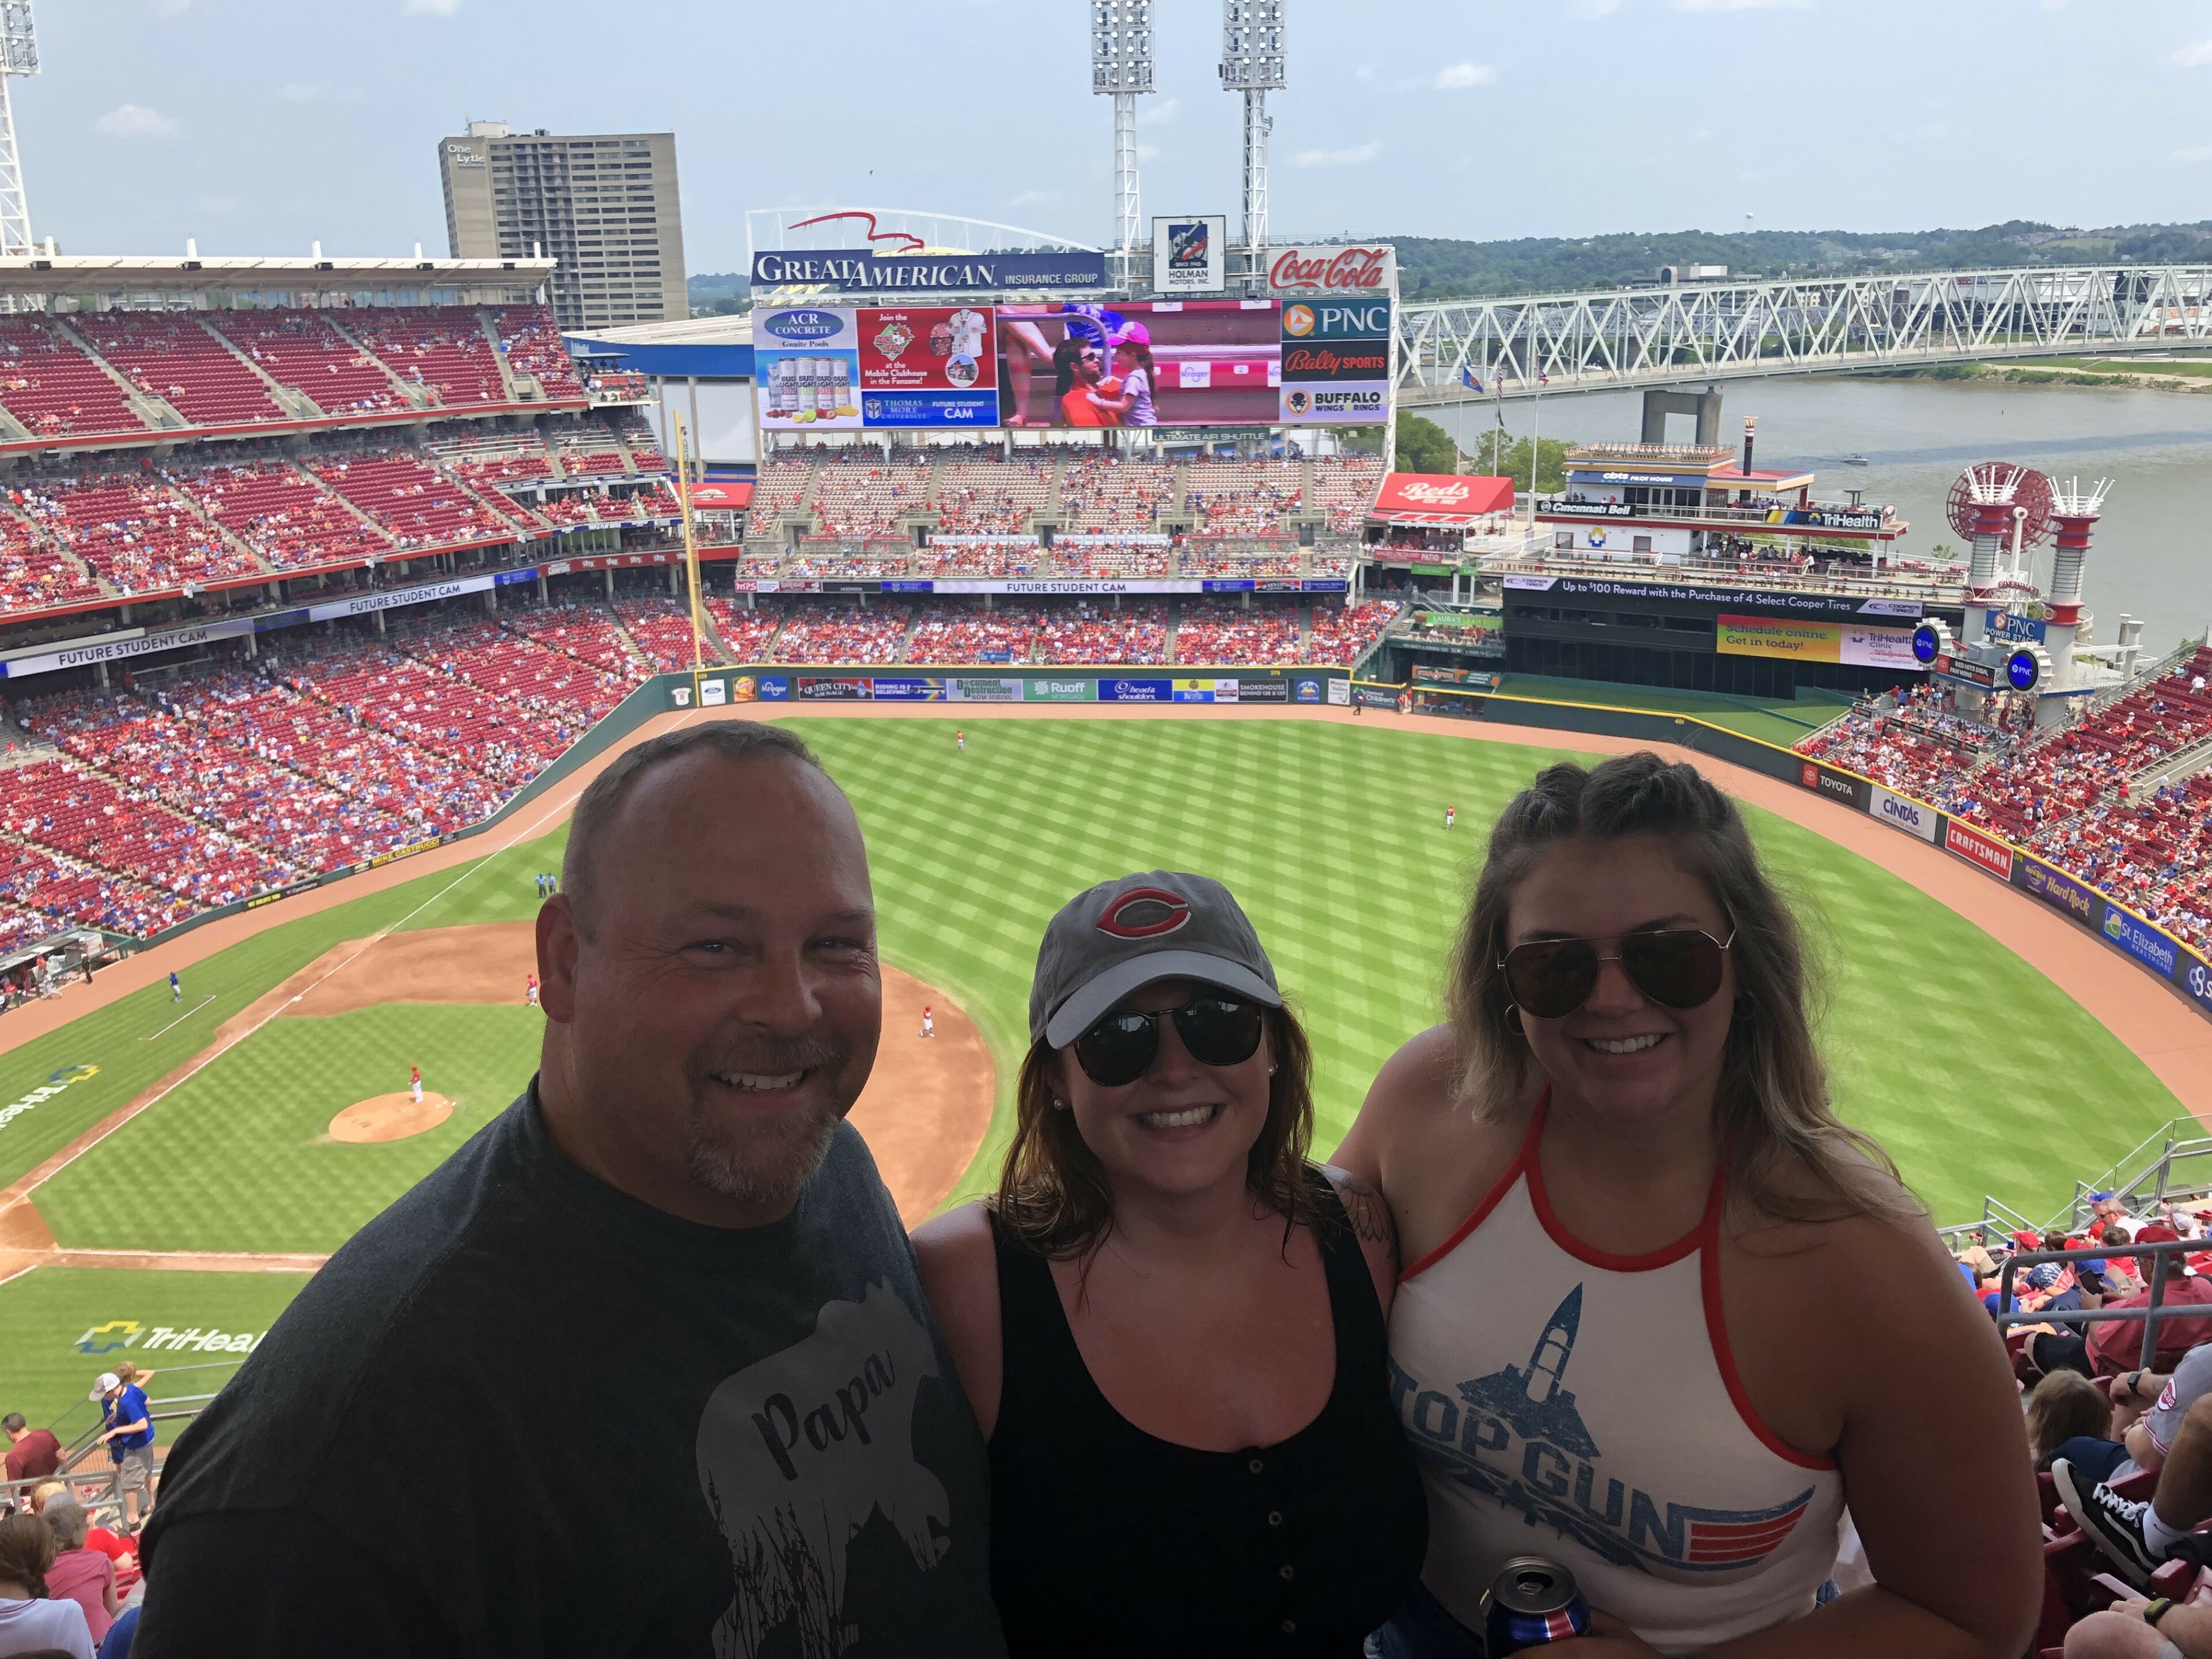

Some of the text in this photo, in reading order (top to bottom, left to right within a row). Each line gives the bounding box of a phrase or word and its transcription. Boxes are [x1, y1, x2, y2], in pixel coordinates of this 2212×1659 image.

[448, 144, 471, 153] One
[457, 154, 486, 164] Lytle
[757, 255, 855, 282] GREAT
[1005, 274, 1062, 285] INSURANCE
[1064, 274, 1098, 283] GROUP
[1169, 270, 1209, 278] HOLMAN
[1270, 248, 1390, 289] Coca-Cola
[788, 313, 819, 324] ACR
[1319, 306, 1388, 332] PNC
[775, 326, 831, 335] CONCRETE
[1285, 350, 1385, 376] Bally SPORTS
[1181, 367, 1209, 382] Kroger
[1315, 392, 1381, 404] BUFFALO
[944, 408, 974, 419] CAM
[1397, 482, 1469, 501] Reds
[1552, 502, 1631, 515] Cincinnati Bell
[1821, 513, 1878, 528] TriHealth
[1421, 554, 1440, 562] PATIO
[1007, 583, 1126, 592] FUTURE STUDENT CAM
[350, 583, 461, 612] FUTURE STUDENT CAM
[1563, 581, 1575, 592] Up
[1613, 585, 1646, 596] Reward
[1649, 586, 1668, 597] with
[1671, 588, 1687, 599] the
[1688, 589, 1731, 603] Purchase
[1733, 593, 1744, 603] of
[1745, 594, 1753, 603] 4
[1756, 594, 1786, 607] Select
[1788, 597, 1825, 609] Cooper
[1827, 600, 1851, 611] Tires
[1433, 615, 1461, 623] LAURA'S
[1726, 624, 1783, 637] Schedule
[1986, 626, 2010, 639] POWER
[2007, 617, 2035, 637] PNC
[59, 631, 207, 666] FUTURE STUDENT CAM
[1726, 635, 1804, 652] Get in today!
[1922, 641, 1934, 649] PNC
[1964, 663, 1975, 672] HITS
[2018, 667, 2032, 676] PNC
[762, 681, 787, 696] Kroger
[804, 682, 853, 695] QUEEN CITY
[964, 687, 1013, 698] Destruction
[1051, 683, 1085, 694] Ruoff
[1118, 691, 1156, 700] shoulders
[1366, 695, 1395, 704] Children's
[1820, 775, 1853, 796] TOYOTA
[372, 854, 394, 866] MIKE
[395, 838, 441, 858] CASTRUCCI
[1950, 828, 2008, 870] CRAFTSMAN
[2046, 876, 2090, 917] Hard Rock
[1096, 888, 1192, 941] C
[2132, 929, 2173, 967] Elizabeth
[2131, 943, 2172, 974] HEALTHCARE
[751, 1348, 896, 1482] Papa
[1389, 1366, 1510, 1457] TOP
[1522, 1441, 1686, 1560] GUN
